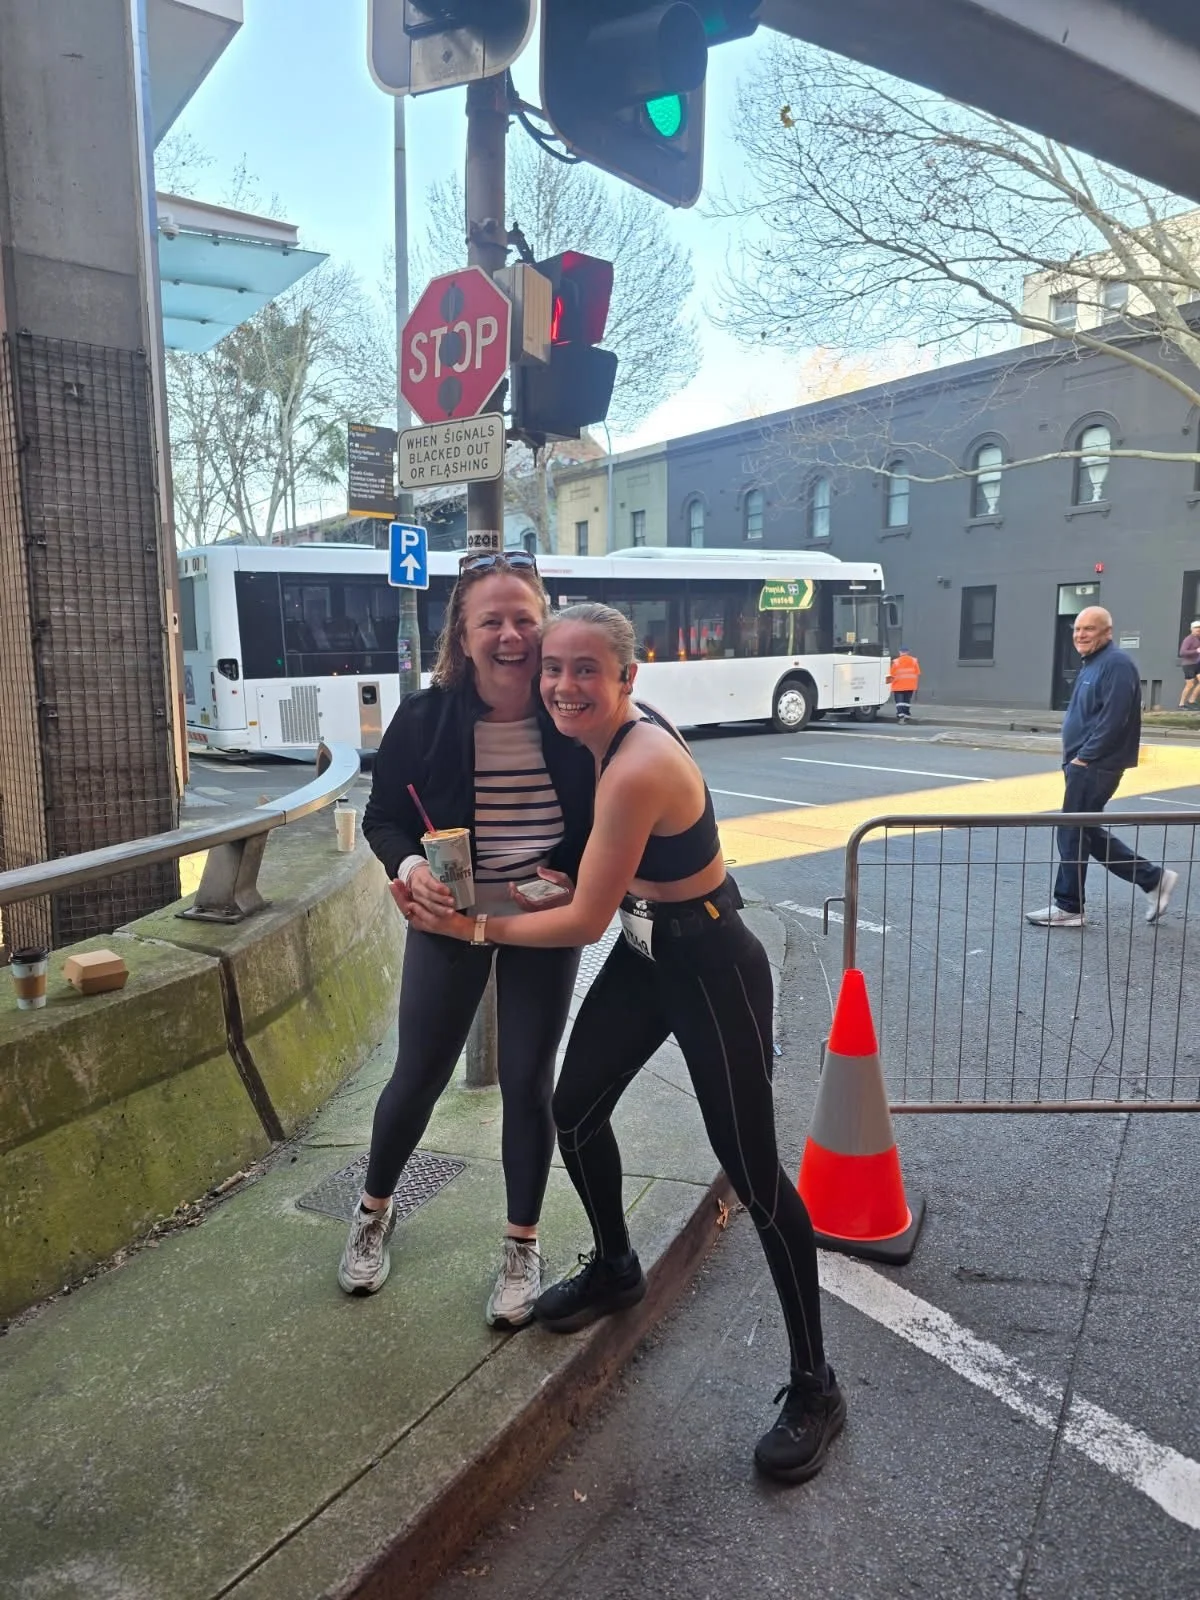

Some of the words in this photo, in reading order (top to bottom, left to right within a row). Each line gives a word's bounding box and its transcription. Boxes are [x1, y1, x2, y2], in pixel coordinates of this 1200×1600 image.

[409, 315, 498, 383] STOP
[406, 434, 438, 450] WHEN
[443, 425, 495, 444] SIGNALS
[409, 446, 462, 464] BLACKED
[466, 441, 490, 456] OUT
[410, 467, 425, 480] OR
[430, 458, 489, 477] FLASHING
[401, 529, 419, 555] P
[633, 909, 648, 918] TATA
